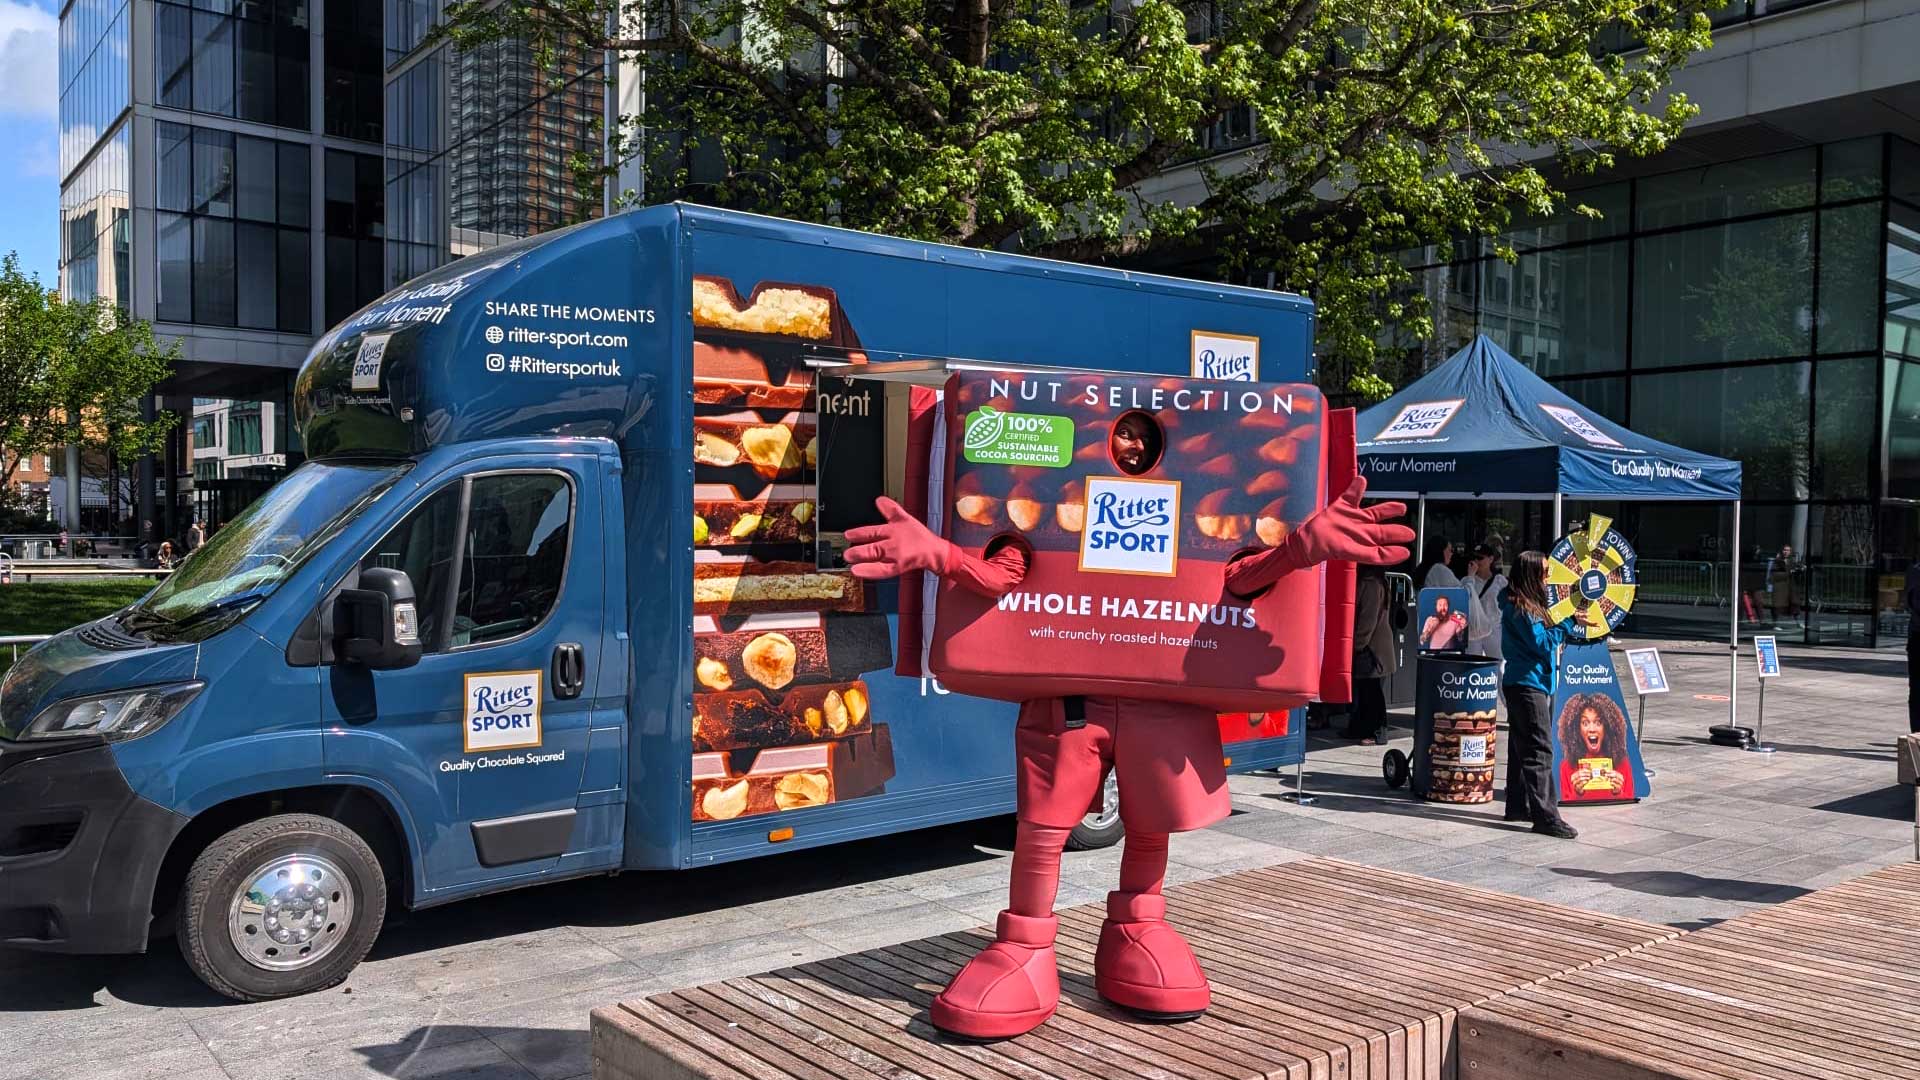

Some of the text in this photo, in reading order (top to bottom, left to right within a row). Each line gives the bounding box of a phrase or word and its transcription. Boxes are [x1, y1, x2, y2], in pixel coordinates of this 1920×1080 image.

[377, 303, 452, 324] Moment
[485, 301, 656, 323] SHARE THE MOMENTS
[508, 327, 628, 349] ritter-sport.com
[354, 363, 379, 376] SPORT
[509, 356, 621, 379] #Rittersportuk
[1200, 349, 1251, 381] Ritter
[990, 379, 1293, 415] NUT SELECTION
[1007, 416, 1054, 433] 100%
[1402, 407, 1452, 423] Ritter
[1389, 421, 1441, 432] SPORT
[1004, 432, 1040, 442] CERTIFIED
[975, 450, 1060, 463] COCOA SOURCING
[997, 441, 1060, 453] SUSTAINABLE
[1369, 457, 1398, 472] Your
[1400, 457, 1457, 472] Moment
[1612, 459, 1627, 475] Our
[1628, 460, 1655, 481] Quality
[1654, 461, 1671, 478] Your
[1092, 491, 1170, 530] Ritter
[1090, 530, 1169, 553] SPORT
[1607, 531, 1619, 544] TO
[998, 592, 1256, 628] WHOLE HAZELNUTS
[1029, 624, 1218, 650] with crunchy roasted hazelnuts
[1441, 671, 1467, 685] Our
[1564, 674, 1613, 685] Your Moment
[1566, 664, 1609, 677] Our Quality
[473, 685, 533, 714] Ritter
[1436, 684, 1465, 699] Your
[472, 713, 533, 732] SPORT
[439, 750, 565, 772] Quality Chocolate Squared
